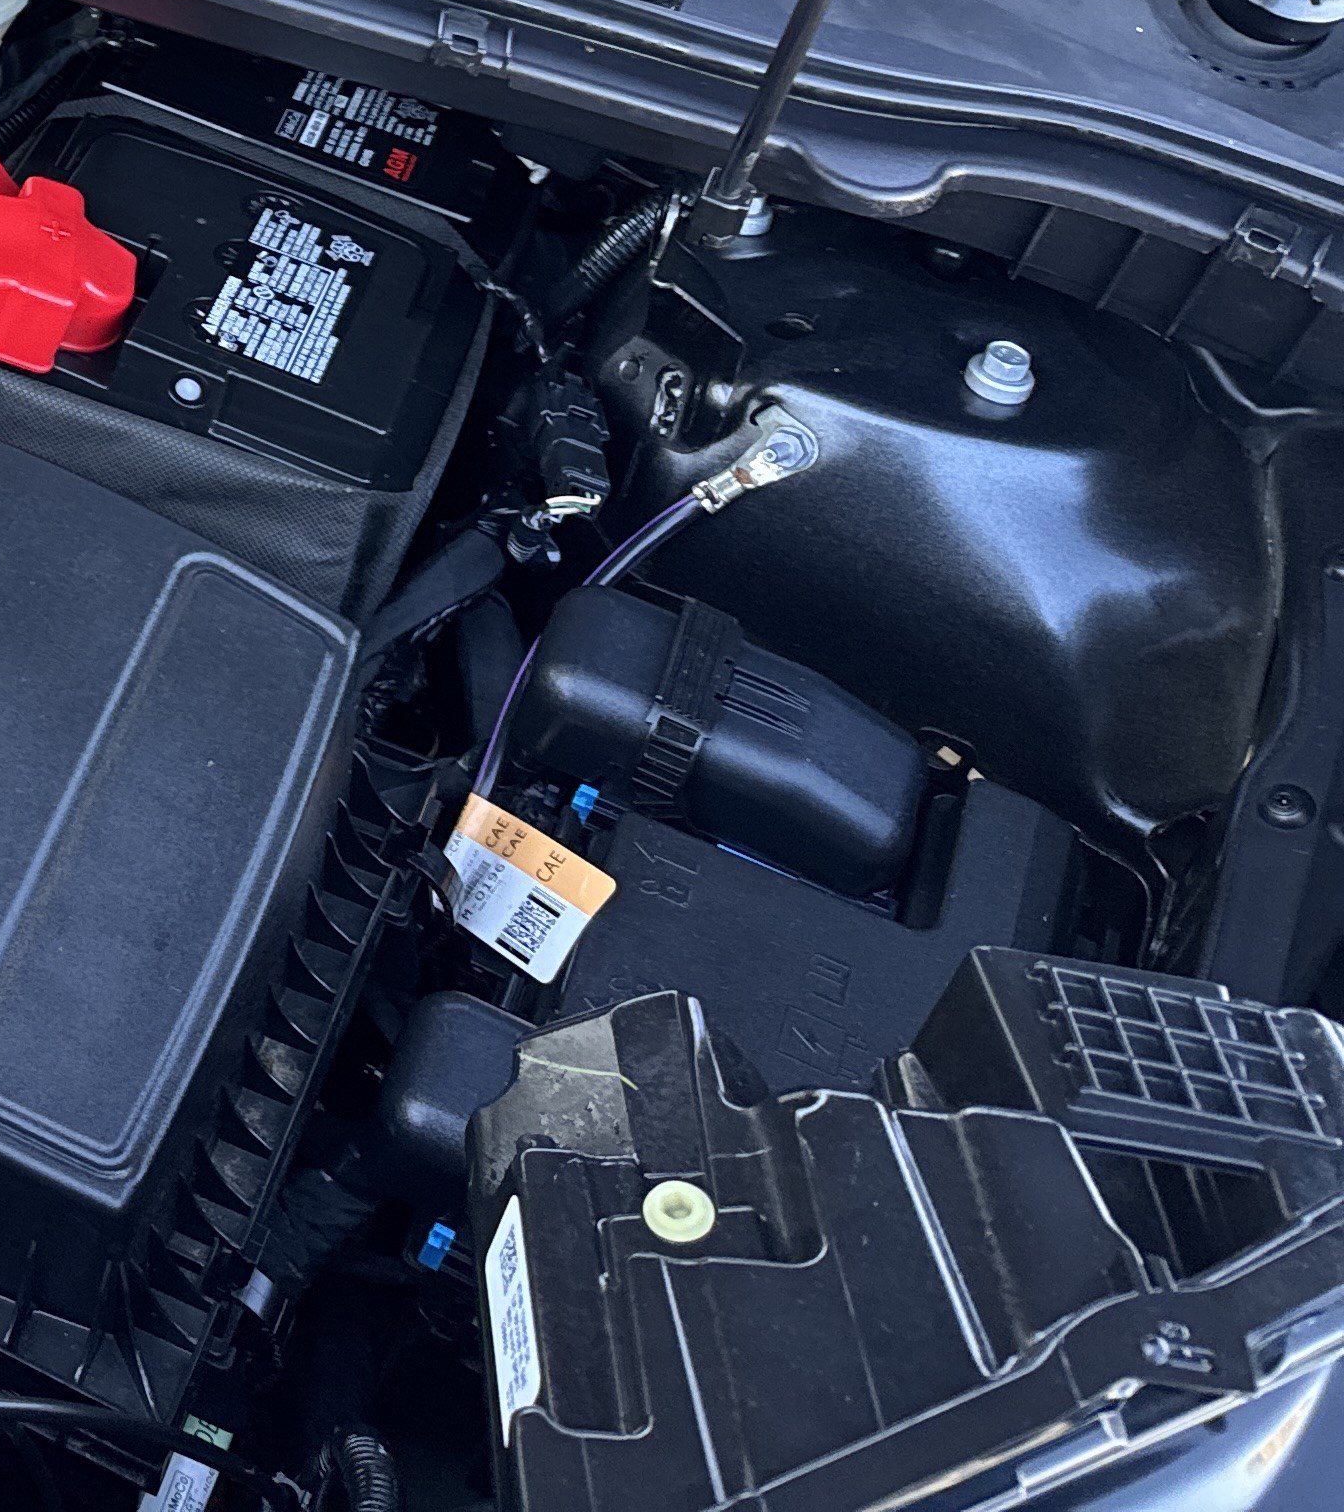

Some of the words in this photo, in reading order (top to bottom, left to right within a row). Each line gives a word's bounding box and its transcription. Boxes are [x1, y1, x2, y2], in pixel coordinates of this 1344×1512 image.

[383, 148, 410, 179] AGM
[486, 816, 510, 849] CAE
[502, 828, 528, 858] CAE
[536, 849, 567, 883] CAE
